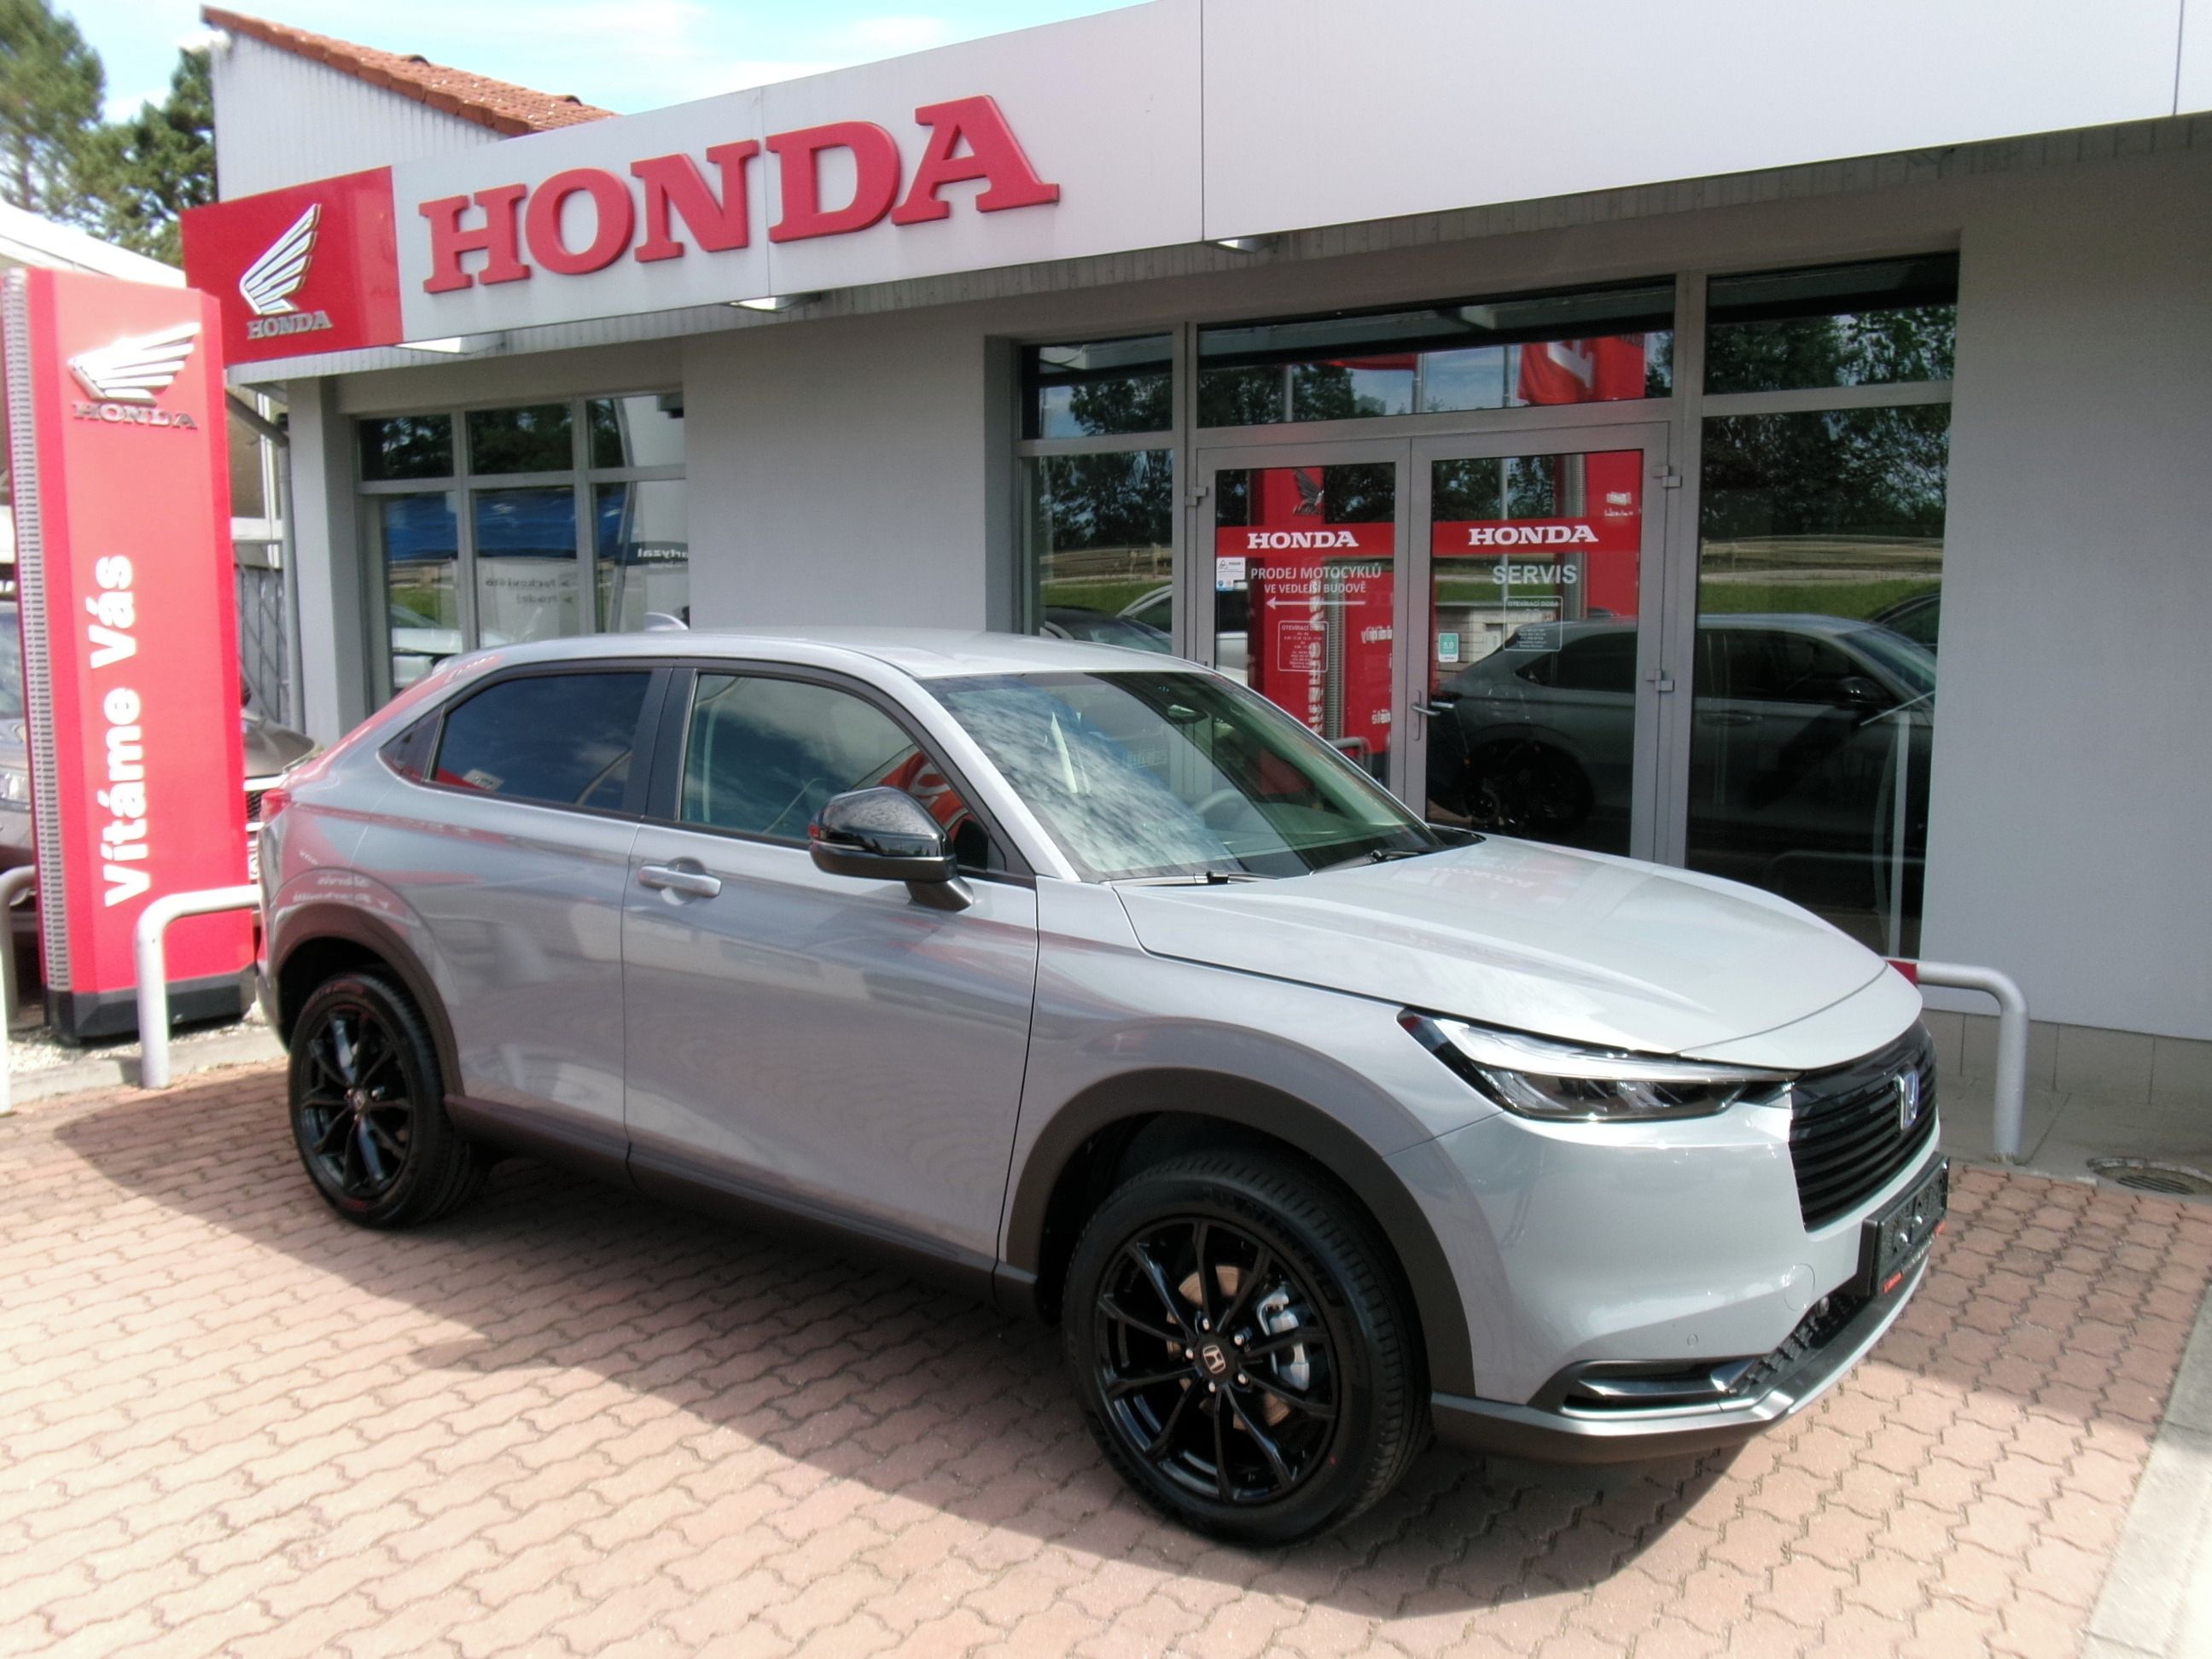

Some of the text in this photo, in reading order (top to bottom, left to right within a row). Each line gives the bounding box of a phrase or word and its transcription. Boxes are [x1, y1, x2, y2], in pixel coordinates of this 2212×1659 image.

[419, 95, 1059, 294] HONDA
[247, 311, 333, 340] HONDA
[73, 400, 198, 430] HONDA
[1247, 531, 1359, 549] HONDA
[1469, 525, 1599, 545] HONDA
[1251, 562, 1382, 580] PRODEJ MOTOCYKLŮ
[1493, 564, 1577, 585] SERVIS
[1264, 583, 1276, 594] VE
[1324, 581, 1366, 593] BUDOVĚ
[85, 556, 151, 907] Vítáme Vás
